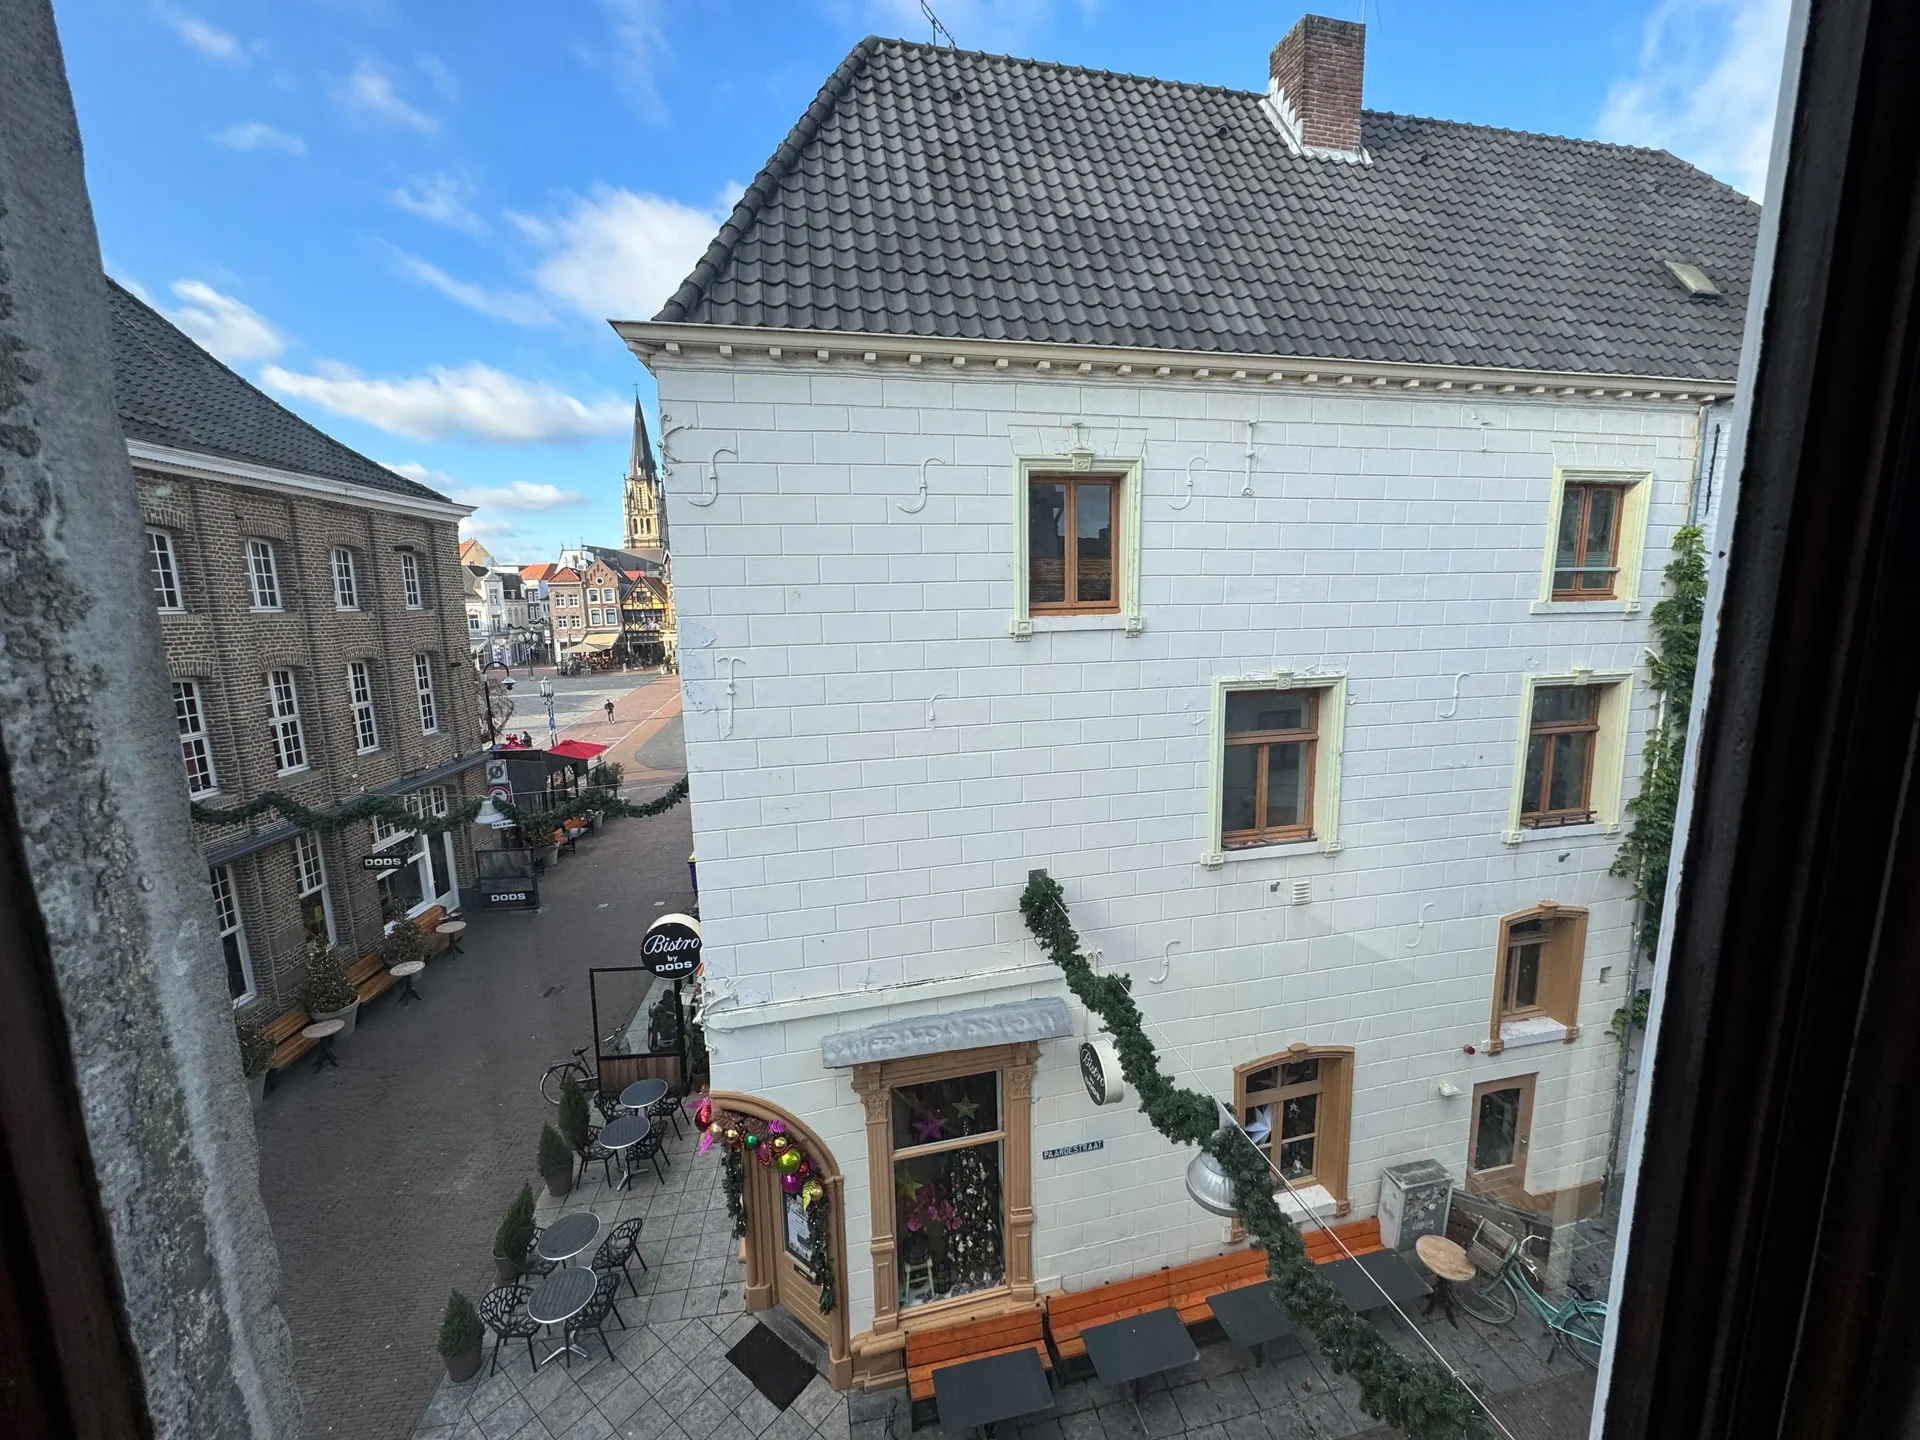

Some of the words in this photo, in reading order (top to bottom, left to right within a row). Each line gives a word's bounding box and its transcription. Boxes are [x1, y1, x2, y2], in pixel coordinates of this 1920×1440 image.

[364, 857, 401, 866] DODS
[490, 892, 526, 902] DODS
[643, 934, 700, 954] Bistro
[655, 960, 693, 972] DODS
[1043, 1141, 1103, 1159] PAARDESTRAAT
